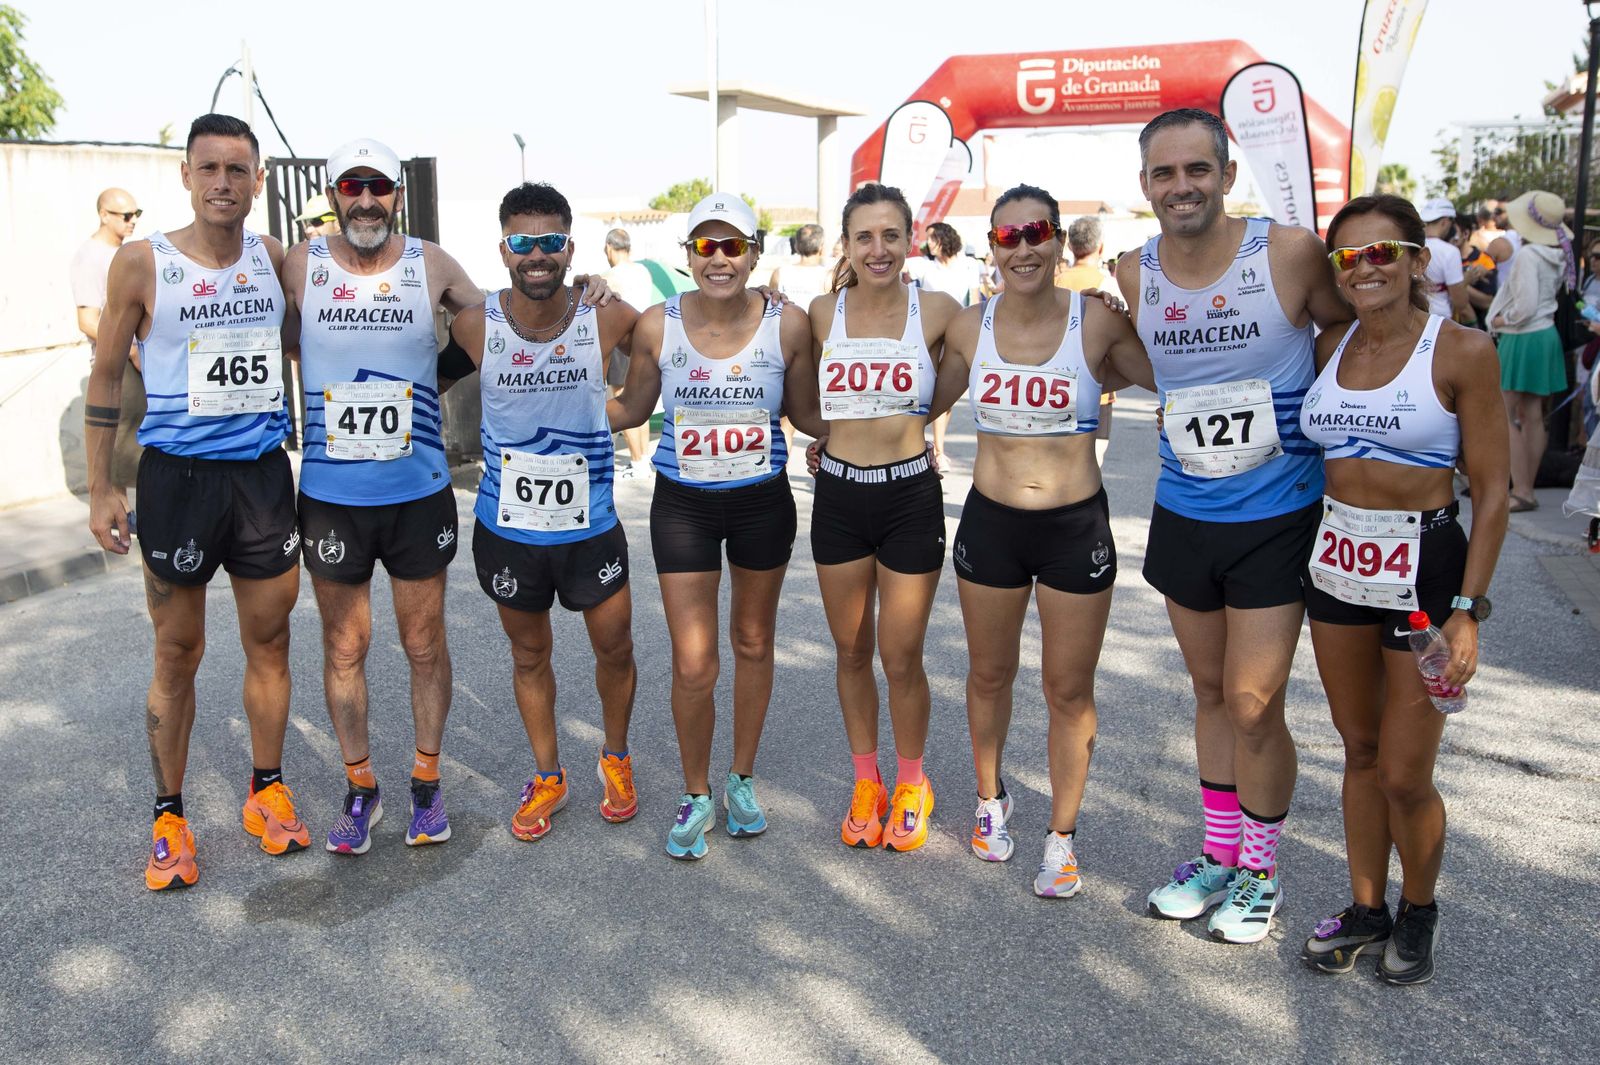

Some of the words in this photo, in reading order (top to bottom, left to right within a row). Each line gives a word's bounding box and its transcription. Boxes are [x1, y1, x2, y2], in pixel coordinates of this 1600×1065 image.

[1062, 55, 1160, 76] Diputación
[1061, 77, 1082, 95] de
[1084, 74, 1160, 95] Granada
[193, 279, 217, 296] als
[234, 286, 259, 294] mayfo
[333, 283, 356, 299] als
[374, 294, 400, 304] mayfo
[180, 298, 274, 321] MARACENA
[318, 308, 414, 324] MARACENA
[1164, 302, 1186, 320] als
[1206, 308, 1240, 320] mayfo
[228, 316, 266, 326] ATLETISMO
[1154, 322, 1260, 346] MARACENA
[512, 349, 534, 365] als
[1199, 343, 1248, 353] ATLETISMO
[550, 356, 575, 364] mayfo
[207, 355, 269, 386] 465
[498, 368, 588, 386] MARACENA
[689, 366, 710, 380] als
[726, 375, 752, 383] mayfo
[826, 362, 913, 392] 2076
[674, 386, 764, 399] MARACENA
[980, 373, 1070, 409] 2105
[338, 406, 399, 434] 470
[1186, 410, 1254, 447] 127
[1310, 414, 1401, 430] MARACENA
[1349, 428, 1388, 436] ATLETISMO
[681, 427, 765, 456] 2102
[846, 466, 887, 483] PUMA
[890, 456, 928, 480] PUMA
[516, 477, 574, 505] 670
[1318, 531, 1412, 578] 2094
[598, 562, 622, 584] als
